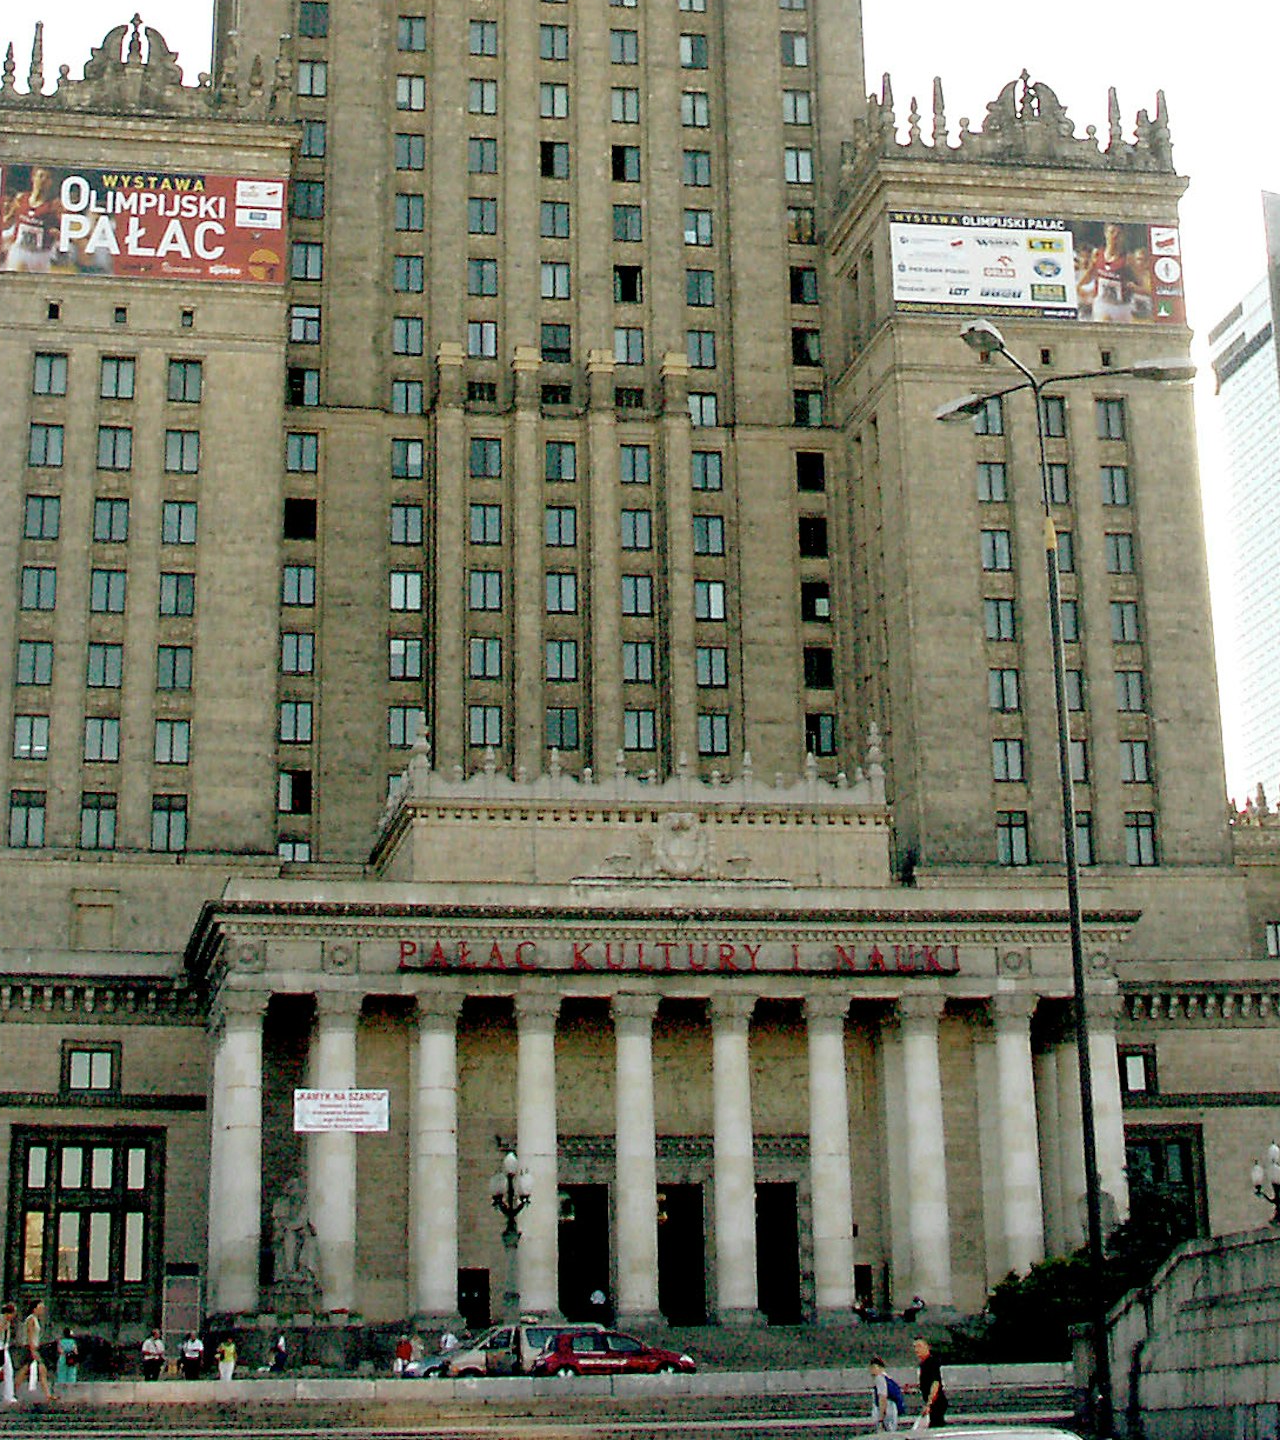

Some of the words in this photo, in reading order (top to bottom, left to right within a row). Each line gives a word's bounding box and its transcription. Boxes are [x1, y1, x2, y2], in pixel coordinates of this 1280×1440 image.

[60, 175, 226, 219] OLIMPIJSKI
[102, 174, 205, 192] WYSTAWA
[58, 213, 226, 260] PAŁAC
[894, 213, 958, 225] WYSTAWA
[961, 215, 1026, 228] OLIMPIJSKI
[398, 940, 539, 970] PAŁAC
[571, 941, 762, 971] KULTURY
[791, 944, 800, 971] I
[834, 944, 960, 972] NAUKI
